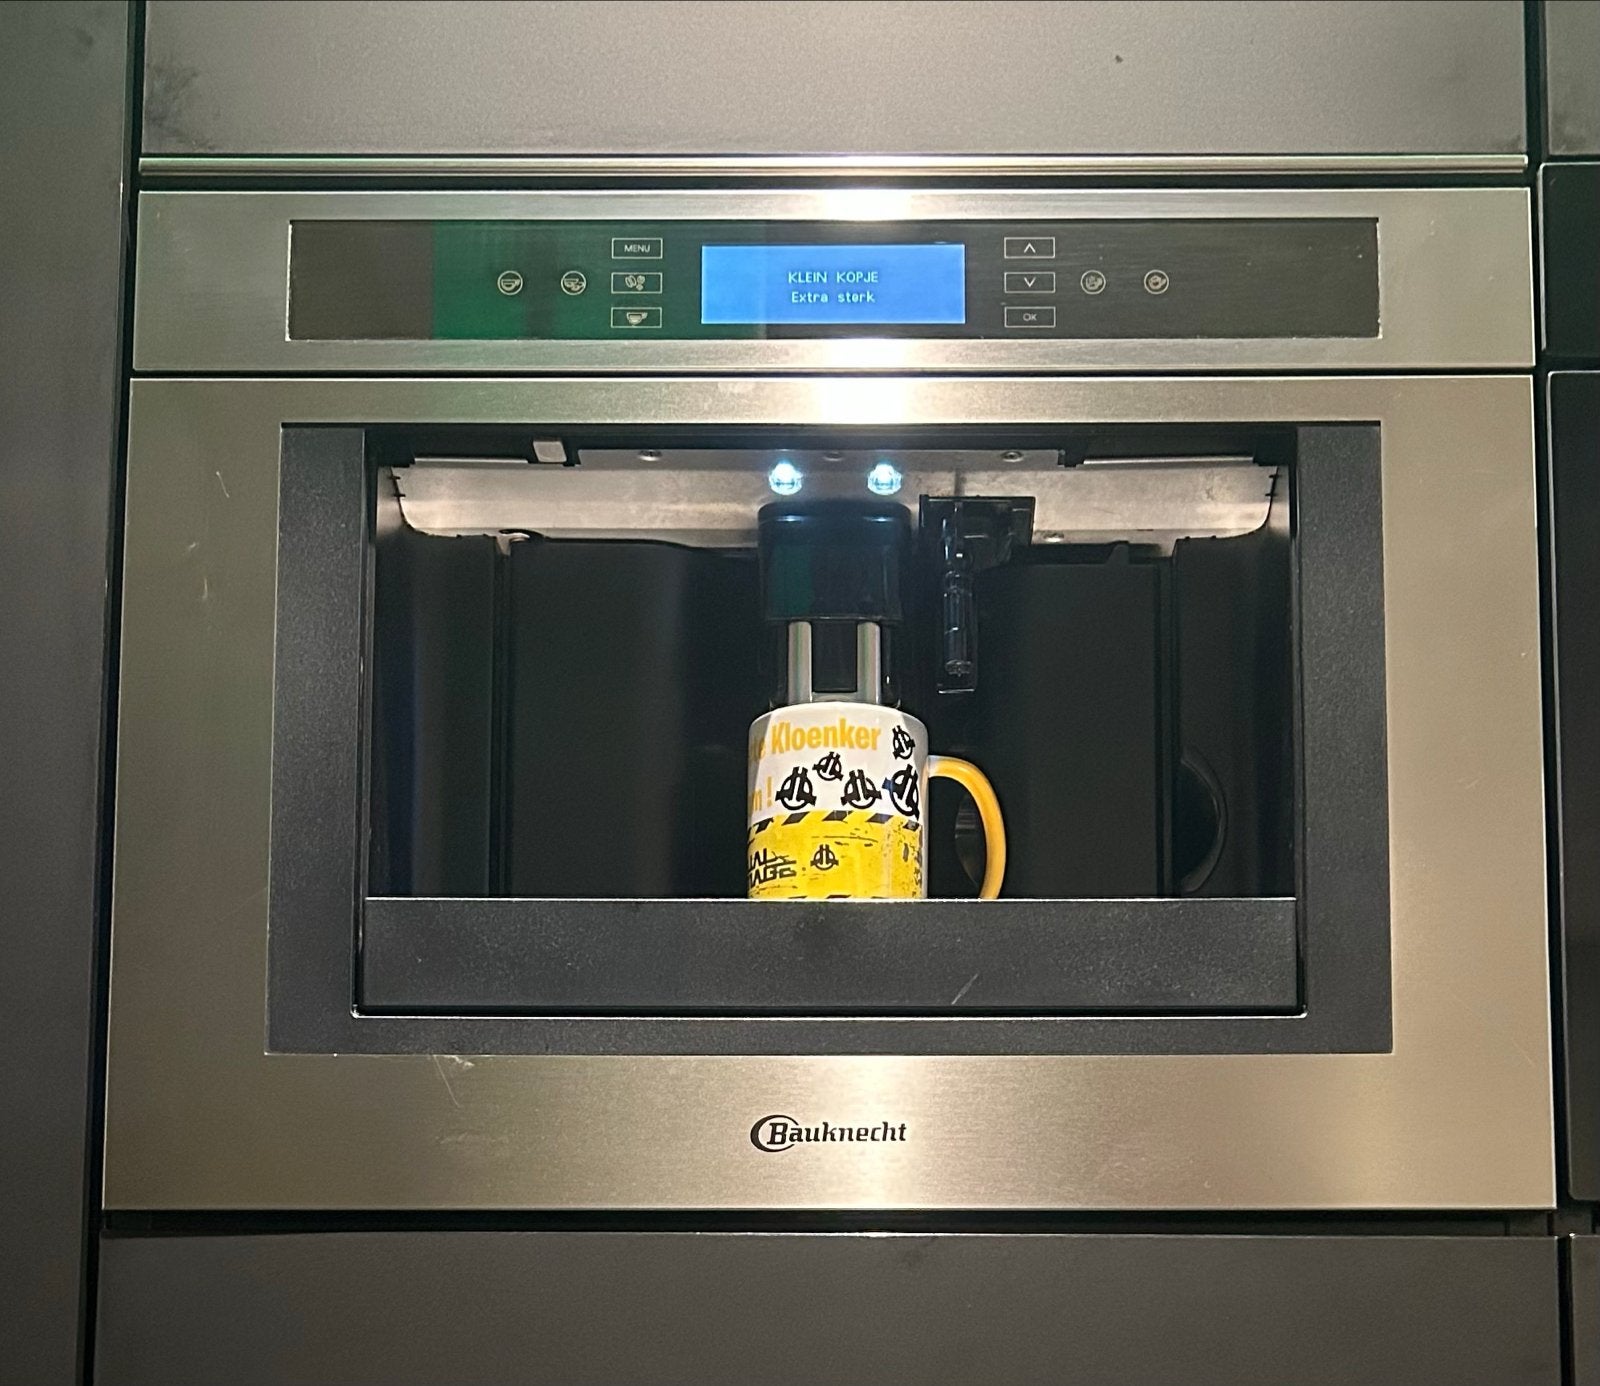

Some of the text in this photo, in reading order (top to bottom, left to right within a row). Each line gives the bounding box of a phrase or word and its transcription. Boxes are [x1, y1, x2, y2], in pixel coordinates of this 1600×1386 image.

[623, 243, 651, 253] MENU
[788, 271, 879, 284] KLEIN KOPJE
[791, 291, 829, 303] Extra
[1022, 312, 1038, 322] OK
[771, 718, 881, 754] Kloenker
[764, 1120, 907, 1147] Bauknecht
